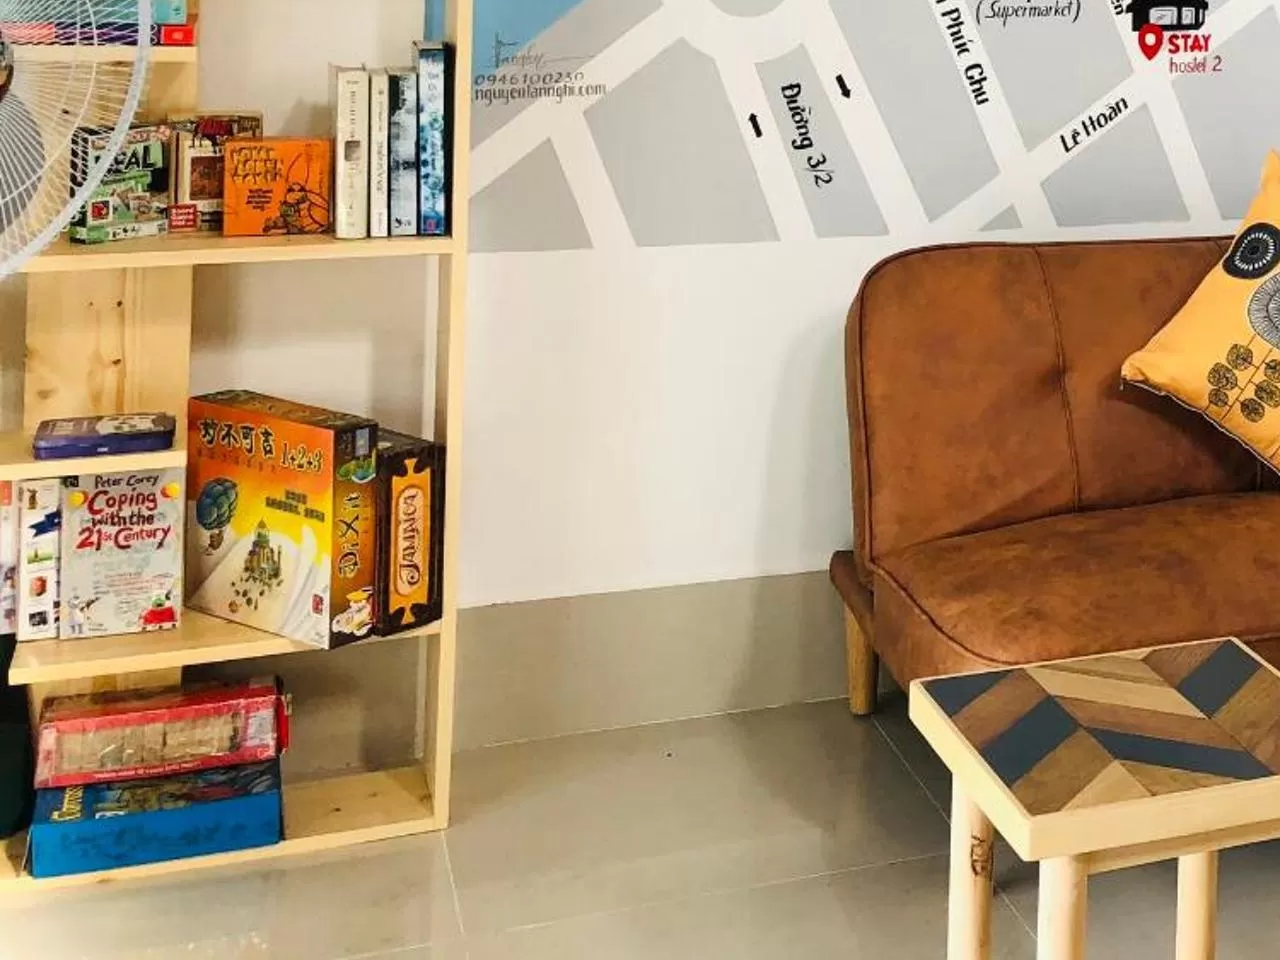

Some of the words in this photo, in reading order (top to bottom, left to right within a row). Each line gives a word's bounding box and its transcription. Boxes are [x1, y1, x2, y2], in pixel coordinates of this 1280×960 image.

[1168, 34, 1211, 53] STAY
[941, 7, 973, 58] Phúc
[963, 63, 990, 106] Chu
[1169, 57, 1206, 73] hostel
[1212, 55, 1222, 72] 2
[781, 81, 814, 150] Đường
[804, 153, 835, 188] 3/2
[1060, 129, 1081, 153] Lê
[1082, 98, 1128, 138] Hoàn
[95, 475, 122, 488] Peter
[88, 487, 157, 515] Coping
[92, 510, 126, 527] with
[130, 507, 154, 525] the
[114, 525, 171, 550] Century
